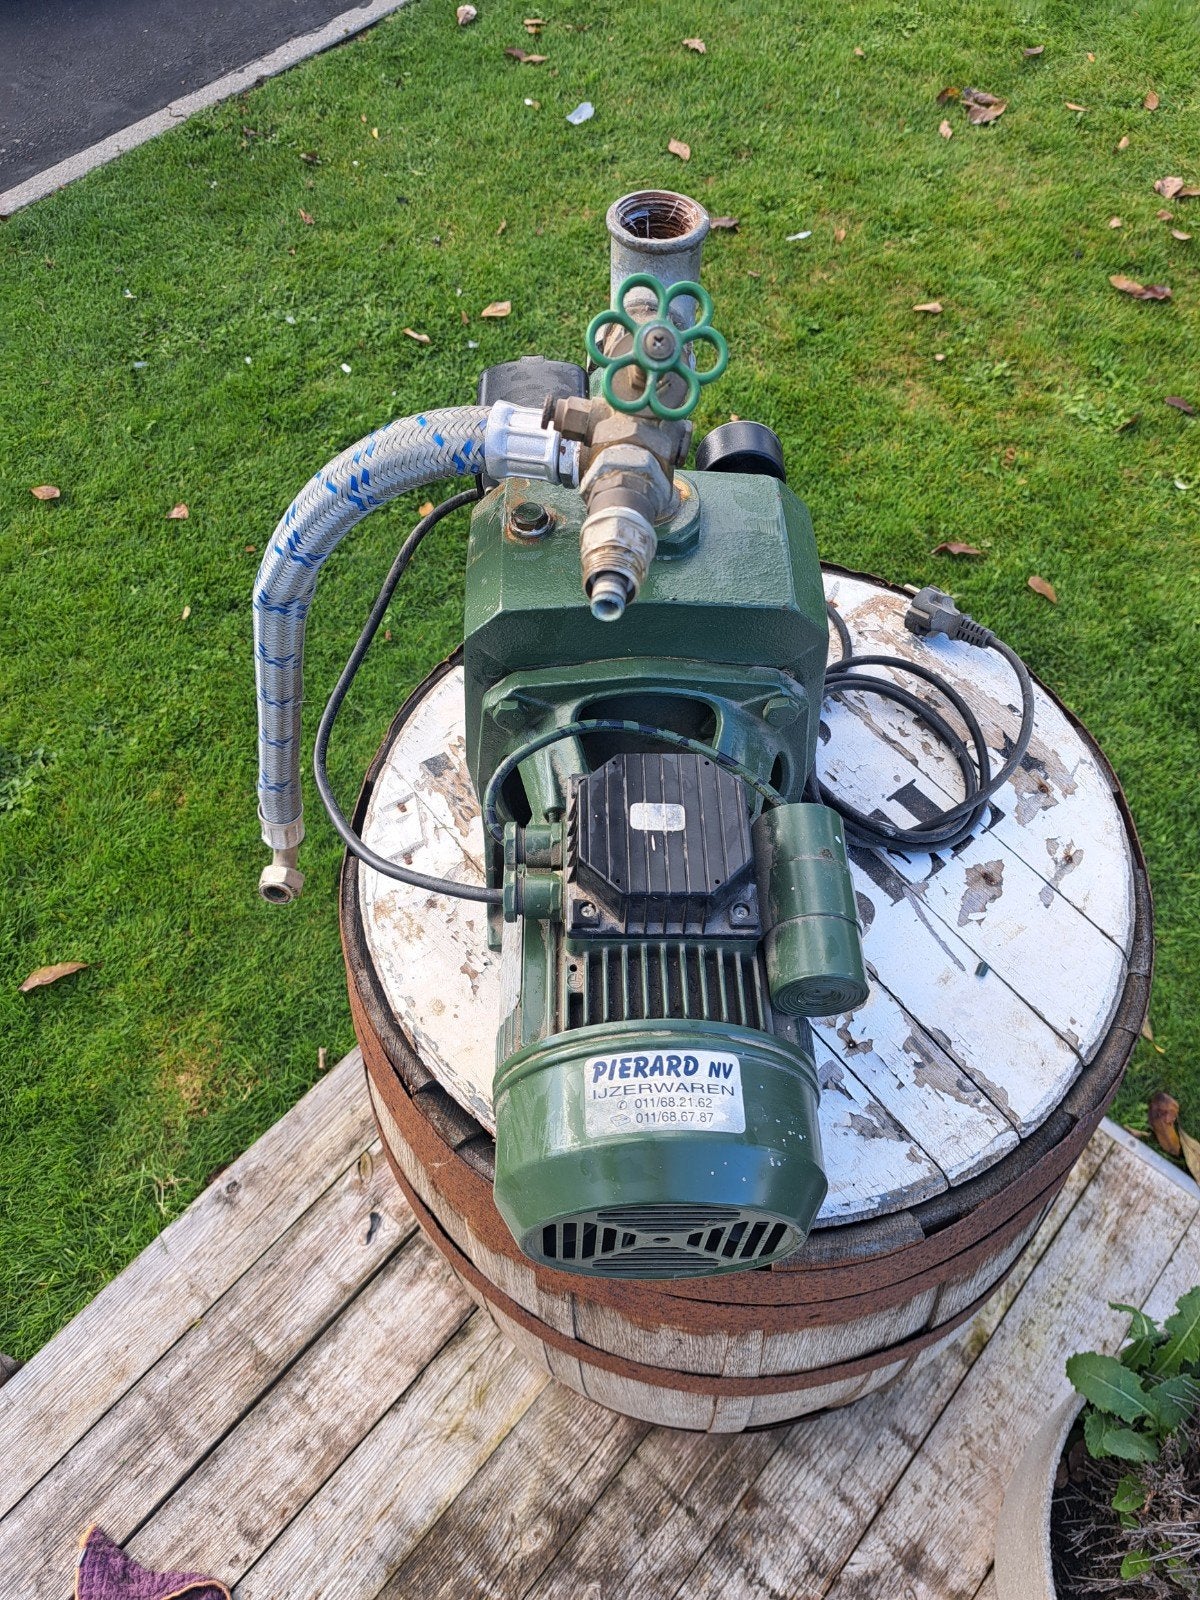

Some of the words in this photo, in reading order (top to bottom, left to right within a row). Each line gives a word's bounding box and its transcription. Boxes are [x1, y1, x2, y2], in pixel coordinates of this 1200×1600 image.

[592, 1055, 699, 1083] PIERARD
[708, 1061, 733, 1079] NV
[593, 1082, 735, 1099] IJZERWAREN
[634, 1097, 713, 1109] 011/68.21.62
[635, 1112, 714, 1124] 011/68.67.87
